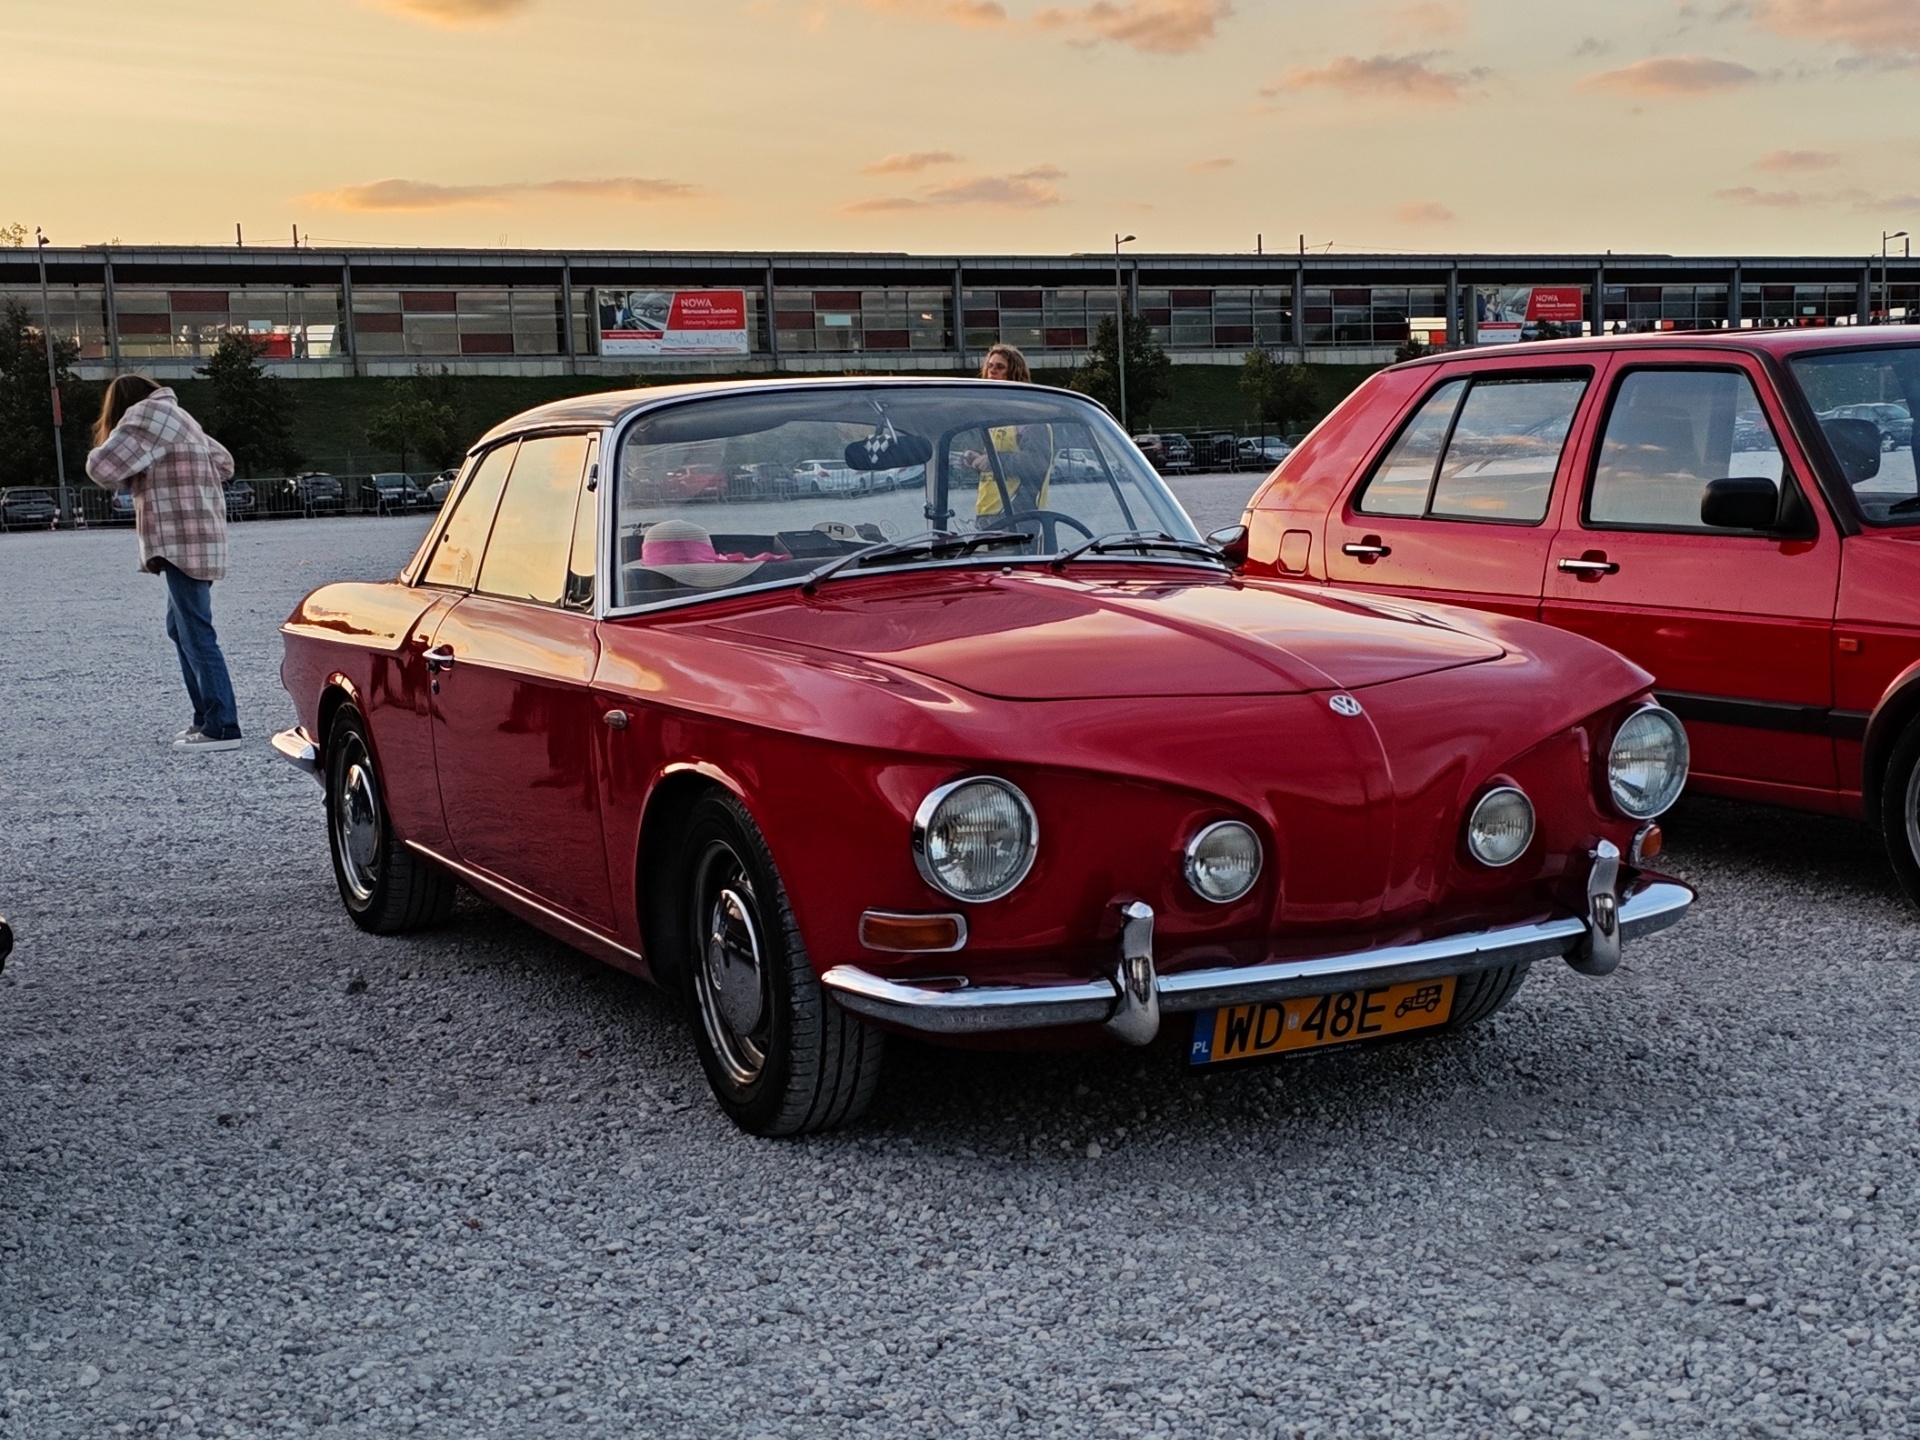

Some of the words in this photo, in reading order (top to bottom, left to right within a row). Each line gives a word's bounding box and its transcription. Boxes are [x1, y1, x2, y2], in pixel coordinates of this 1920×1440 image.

[681, 299, 712, 307] NOWA
[1224, 1002, 1286, 1054] WD
[1301, 987, 1391, 1041] 48E
[1192, 1041, 1209, 1054] PL
[1285, 1049, 1322, 1060] Volkswagen
[1323, 1046, 1344, 1054] Classic
